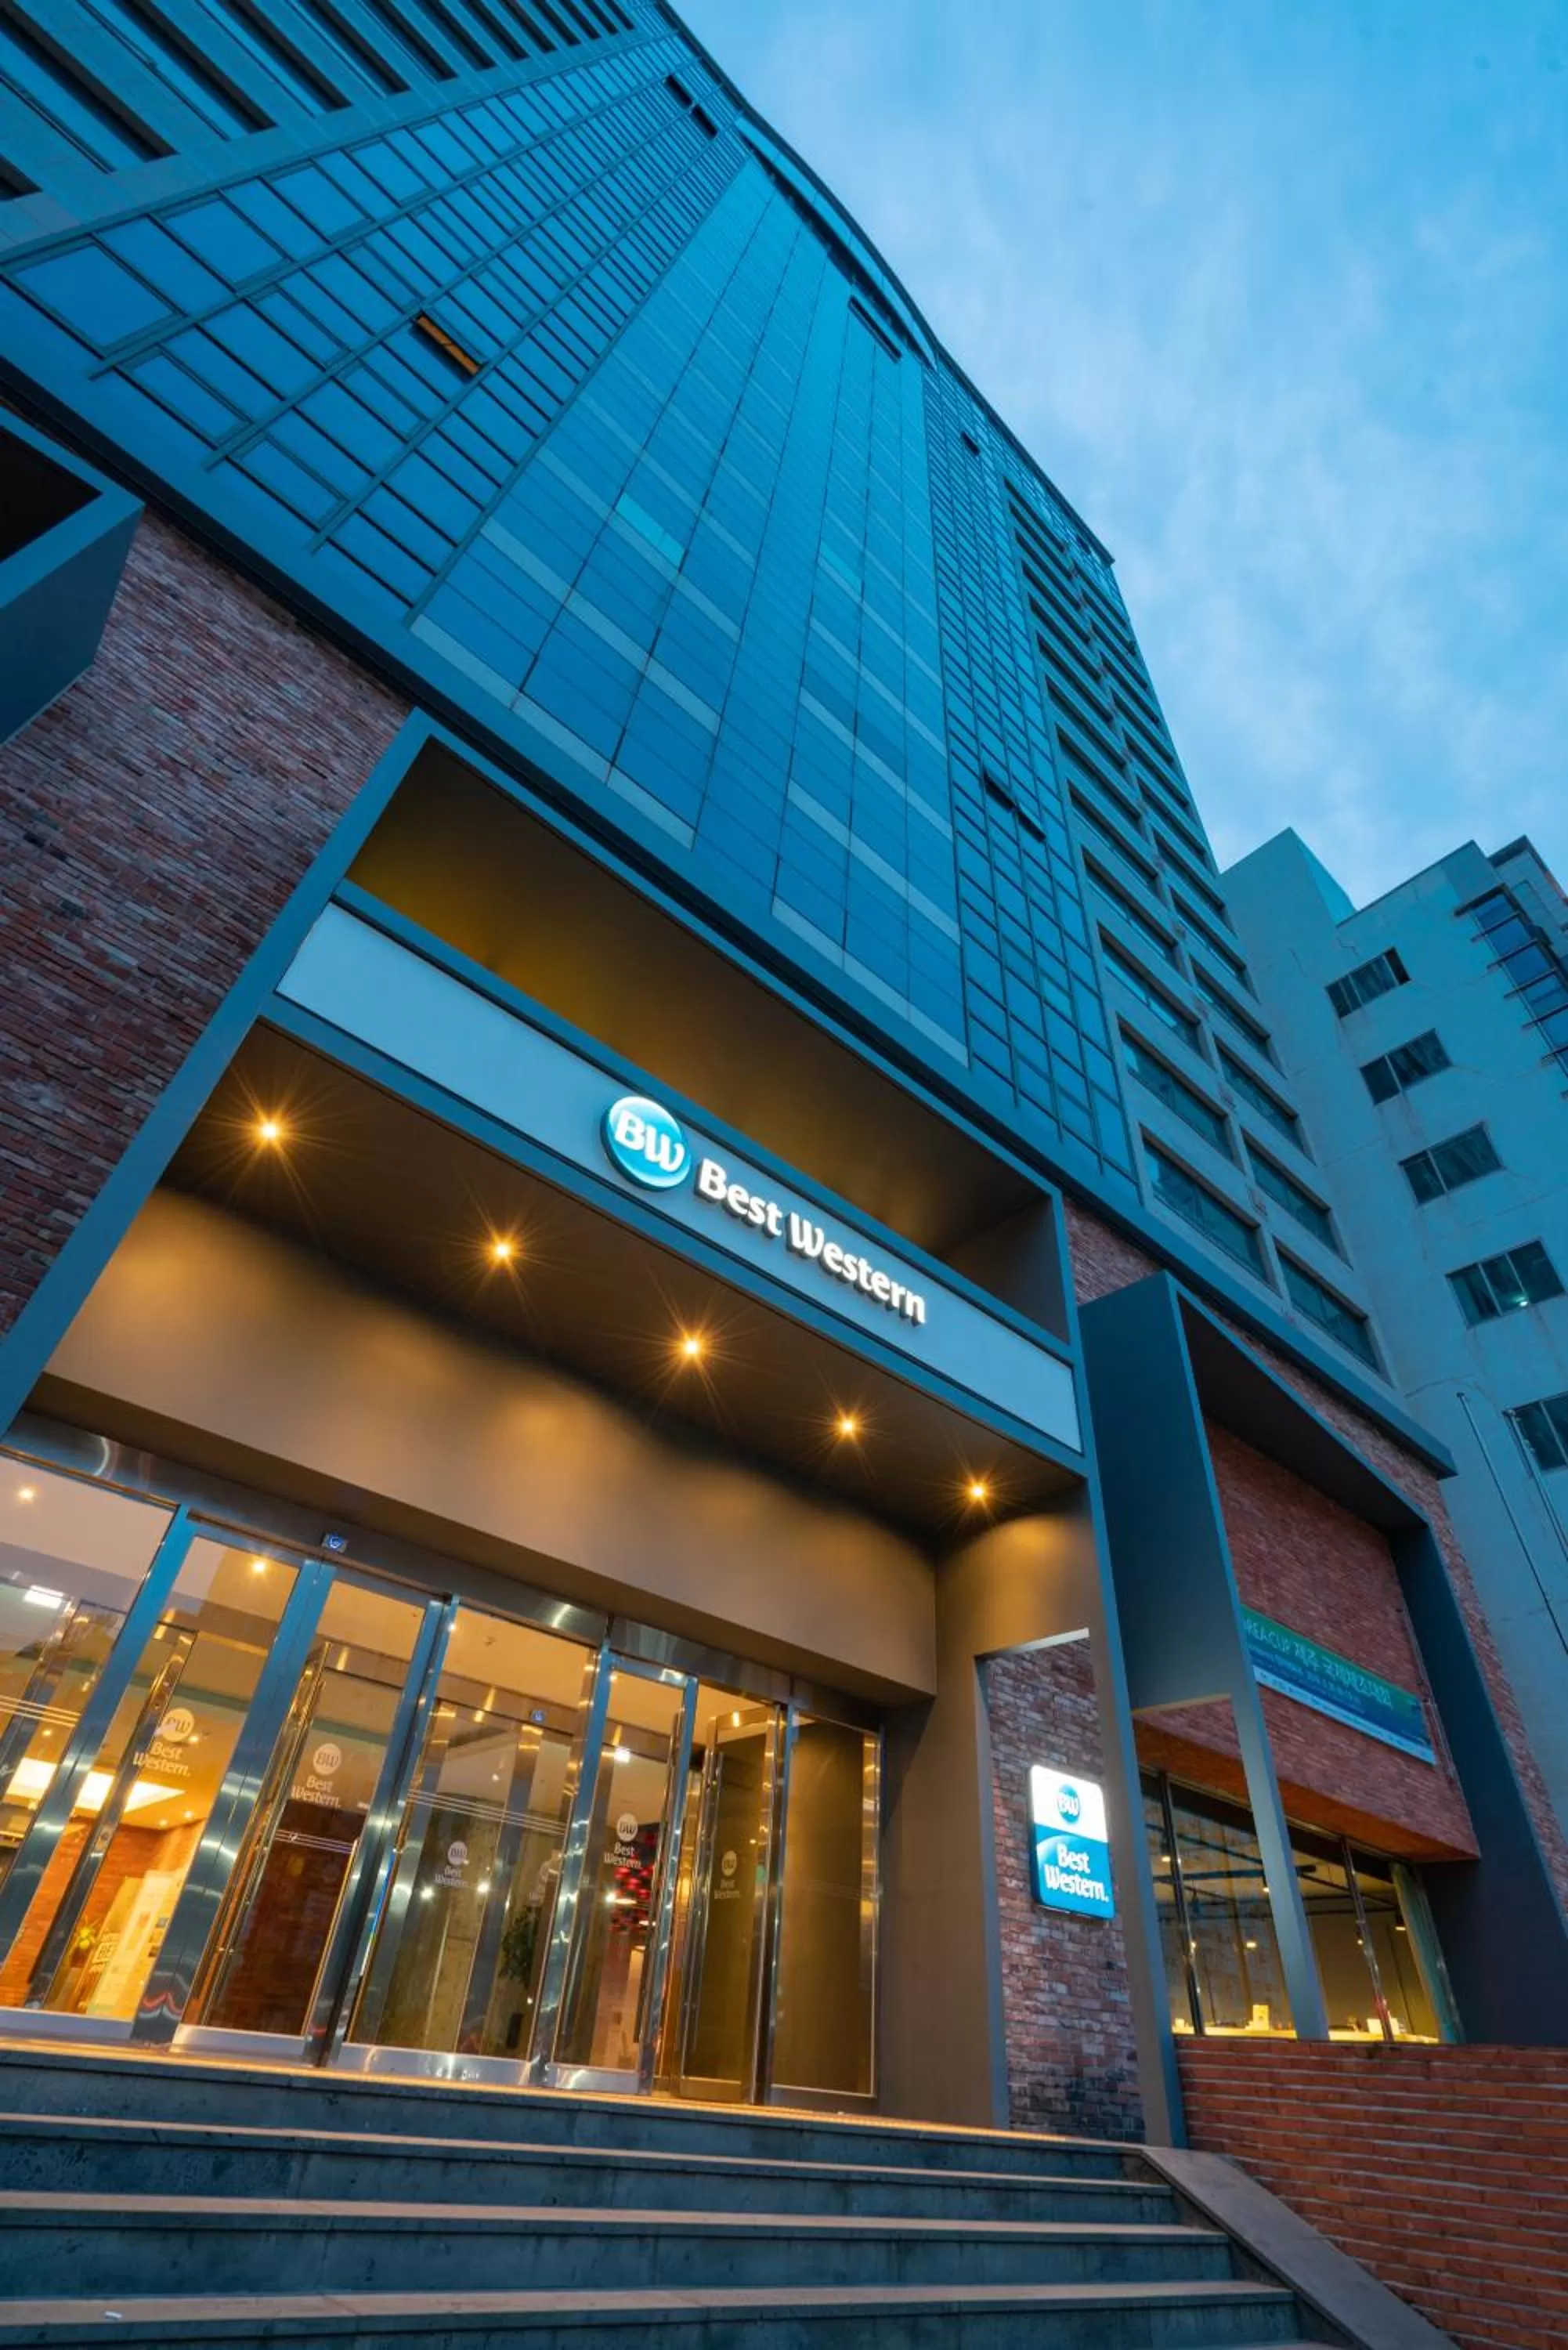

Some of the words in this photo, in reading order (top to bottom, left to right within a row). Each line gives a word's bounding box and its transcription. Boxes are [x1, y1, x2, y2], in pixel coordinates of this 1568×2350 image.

[614, 1109, 685, 1172] BW
[697, 1157, 782, 1237] Best
[788, 1210, 927, 1325] Western
[150, 1741, 182, 1761] Best
[316, 1752, 340, 1768] BW
[306, 1774, 334, 1793] Best
[1057, 1842, 1091, 1875] Best
